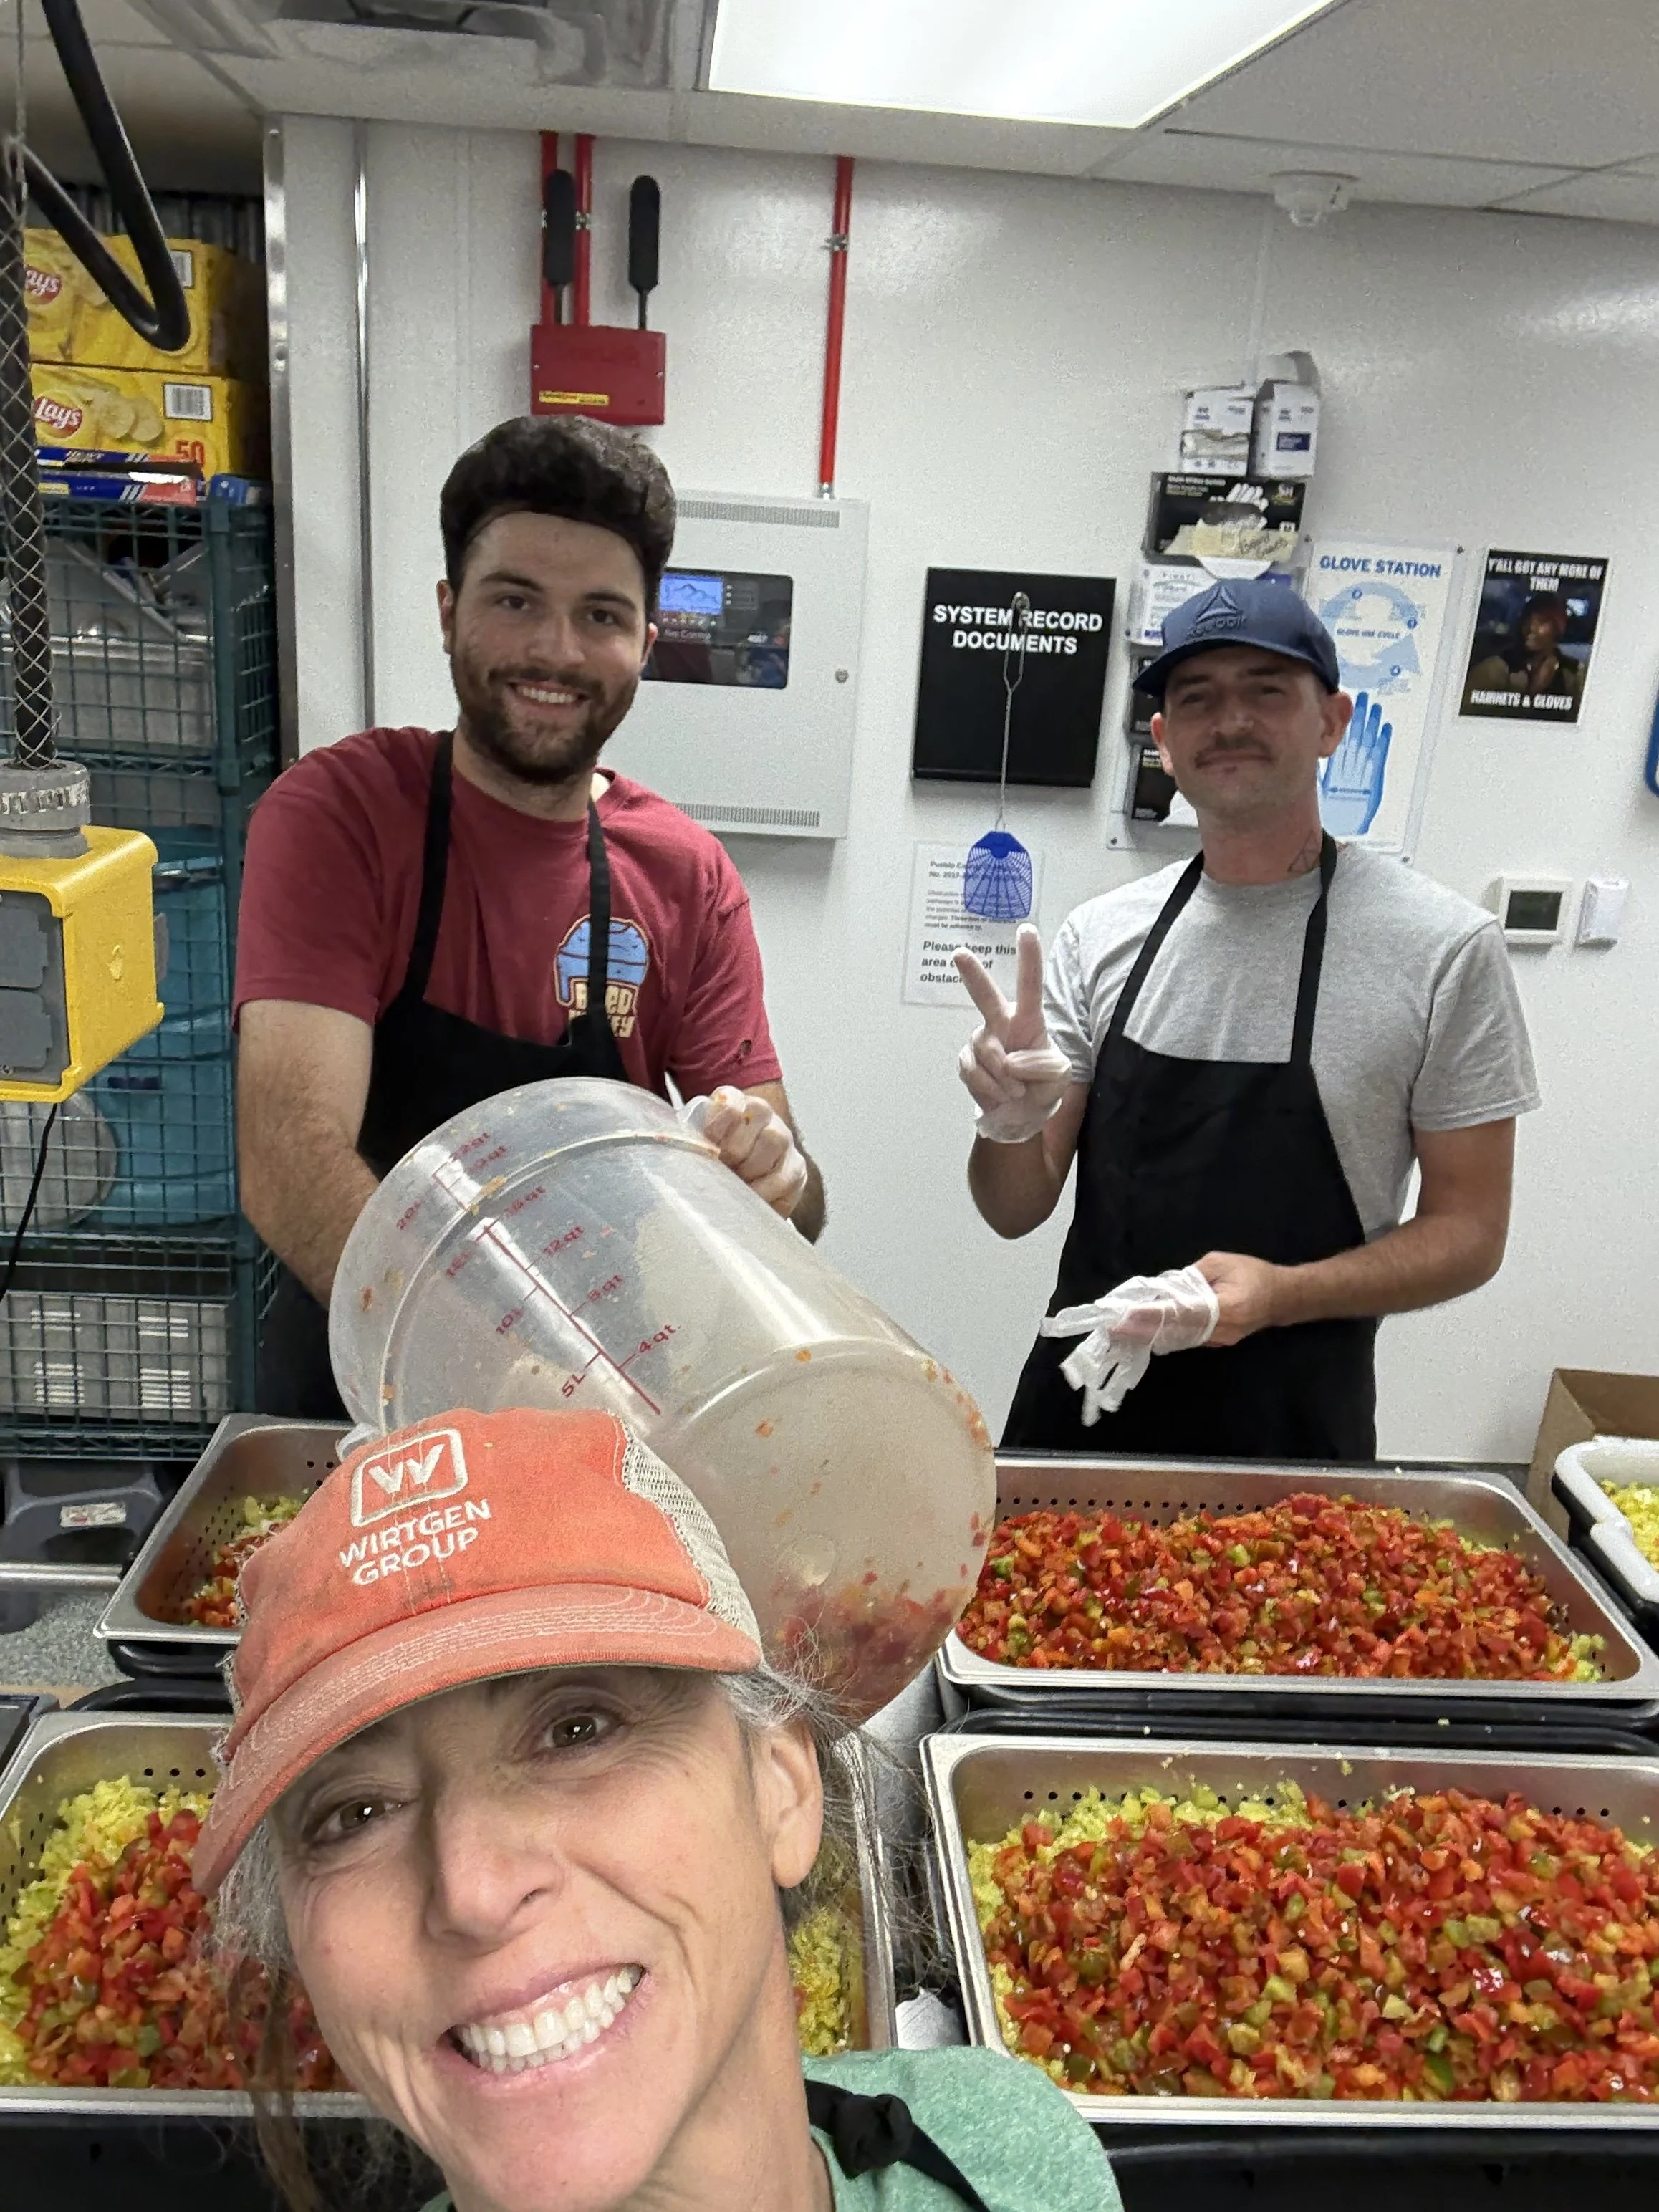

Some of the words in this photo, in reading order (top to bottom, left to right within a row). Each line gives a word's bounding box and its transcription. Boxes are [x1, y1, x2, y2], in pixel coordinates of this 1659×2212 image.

[175, 439, 205, 466] 50
[1320, 555, 1372, 572] GLOVE
[1375, 559, 1441, 578] STATION
[1514, 559, 1536, 574] GOT
[1535, 561, 1559, 576] ANY
[1559, 562, 1588, 578] MORE
[1589, 565, 1603, 580] OF
[1529, 576, 1559, 592] THEM
[933, 604, 1013, 626] SYSTEM
[1018, 610, 1104, 631] RECORD
[952, 630, 1077, 655] DOCUMENTS
[1533, 693, 1574, 711] GLOVES
[995, 944, 1016, 955] this
[921, 958, 946, 967] area
[525, 1186, 545, 1202] qt
[564, 1226, 585, 1242] qt
[602, 1275, 623, 1290] qt
[639, 1340, 652, 1353] 4
[653, 1324, 676, 1343] qt
[561, 1373, 587, 1399] 5L
[339, 1498, 492, 1567] WIRTGEN
[351, 1526, 479, 1586] GROUP
